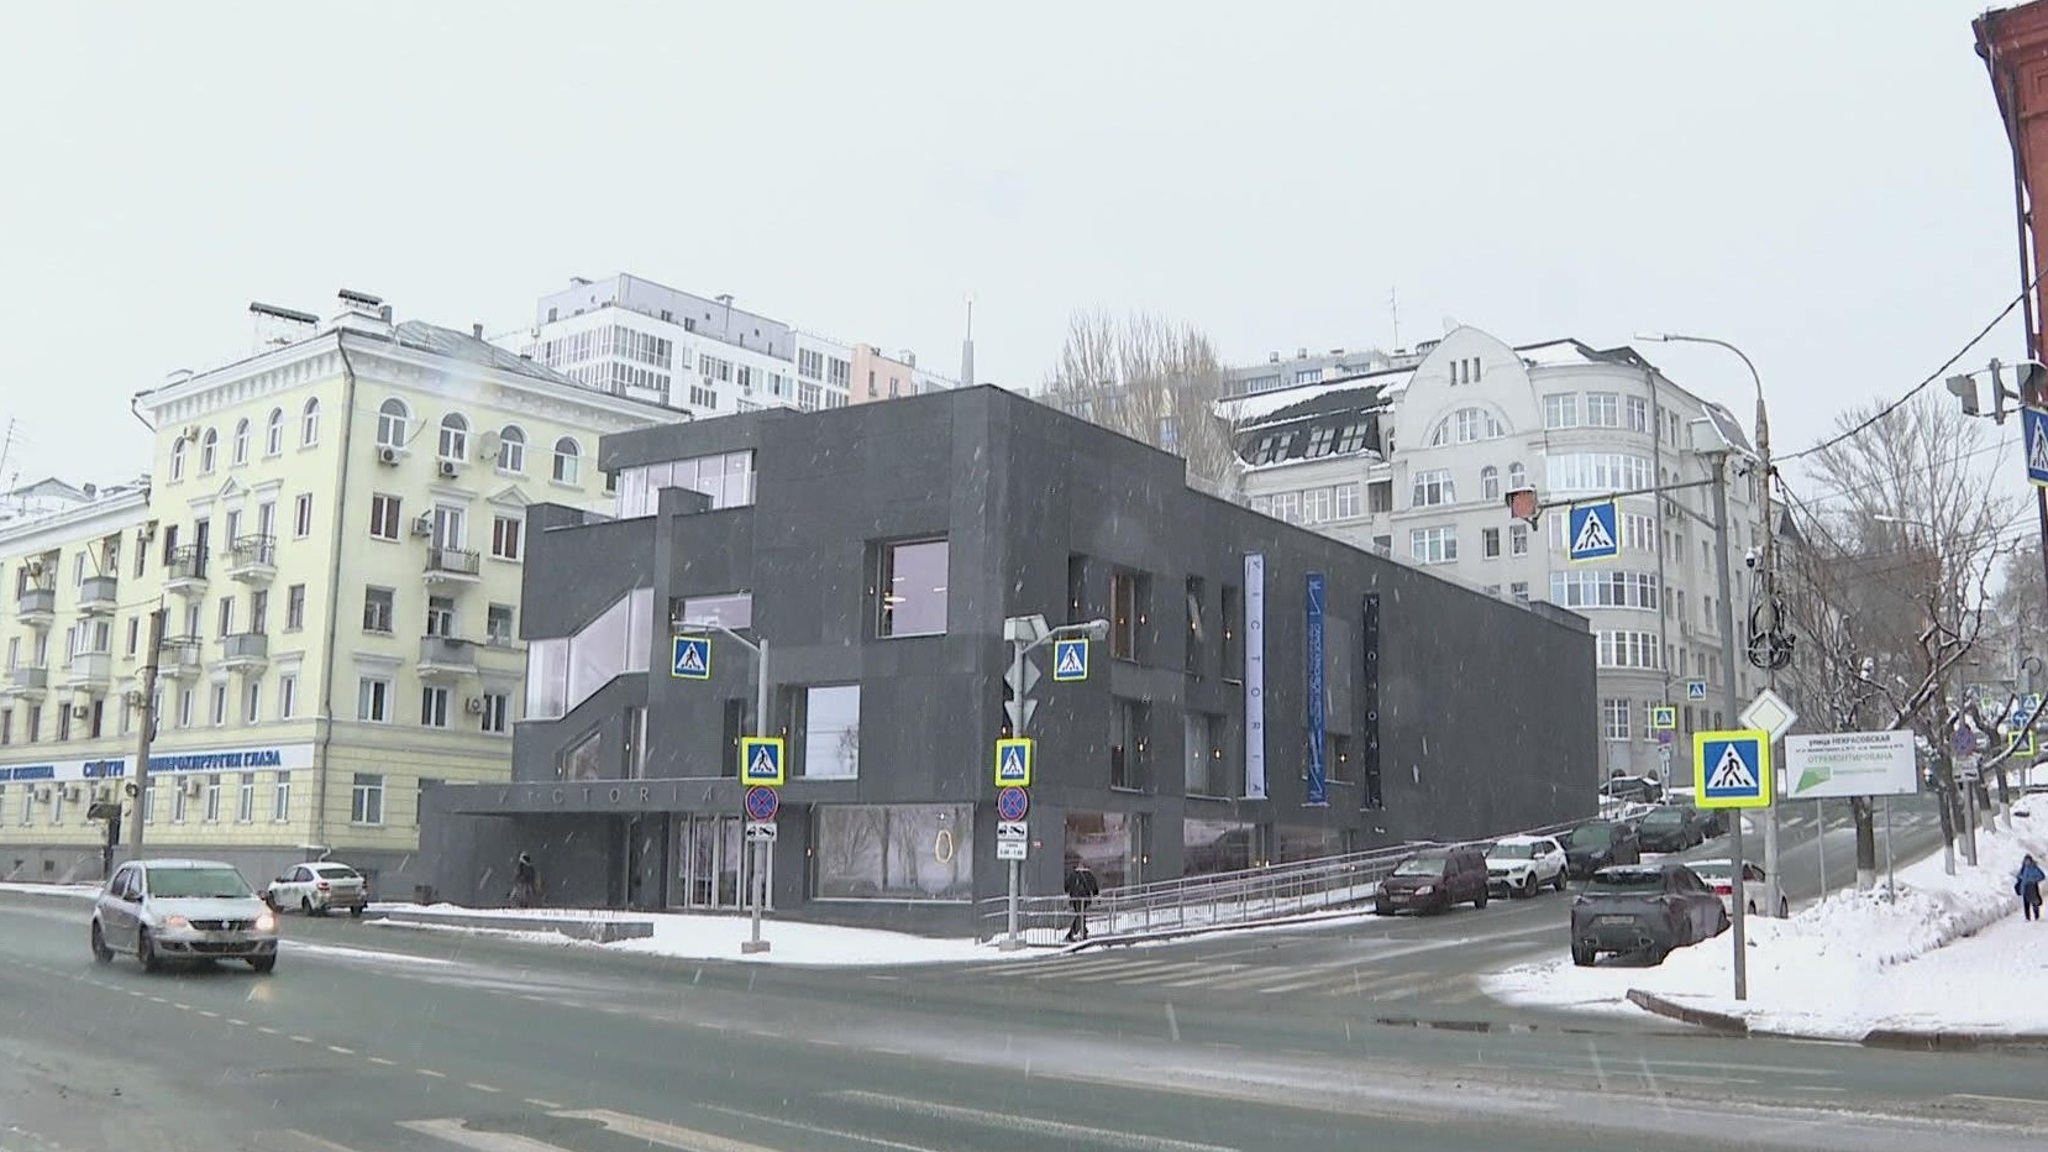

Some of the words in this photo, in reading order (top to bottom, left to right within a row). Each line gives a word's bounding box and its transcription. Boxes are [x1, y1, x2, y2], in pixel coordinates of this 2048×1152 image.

[1250, 560, 1261, 792] VICTORIA
[1832, 734, 1891, 745] НЕКРАСОВСКАЯ
[244, 750, 281, 767] ГЛАЗА
[1807, 752, 1893, 764] ОТРЕМОНТИРОВАНА
